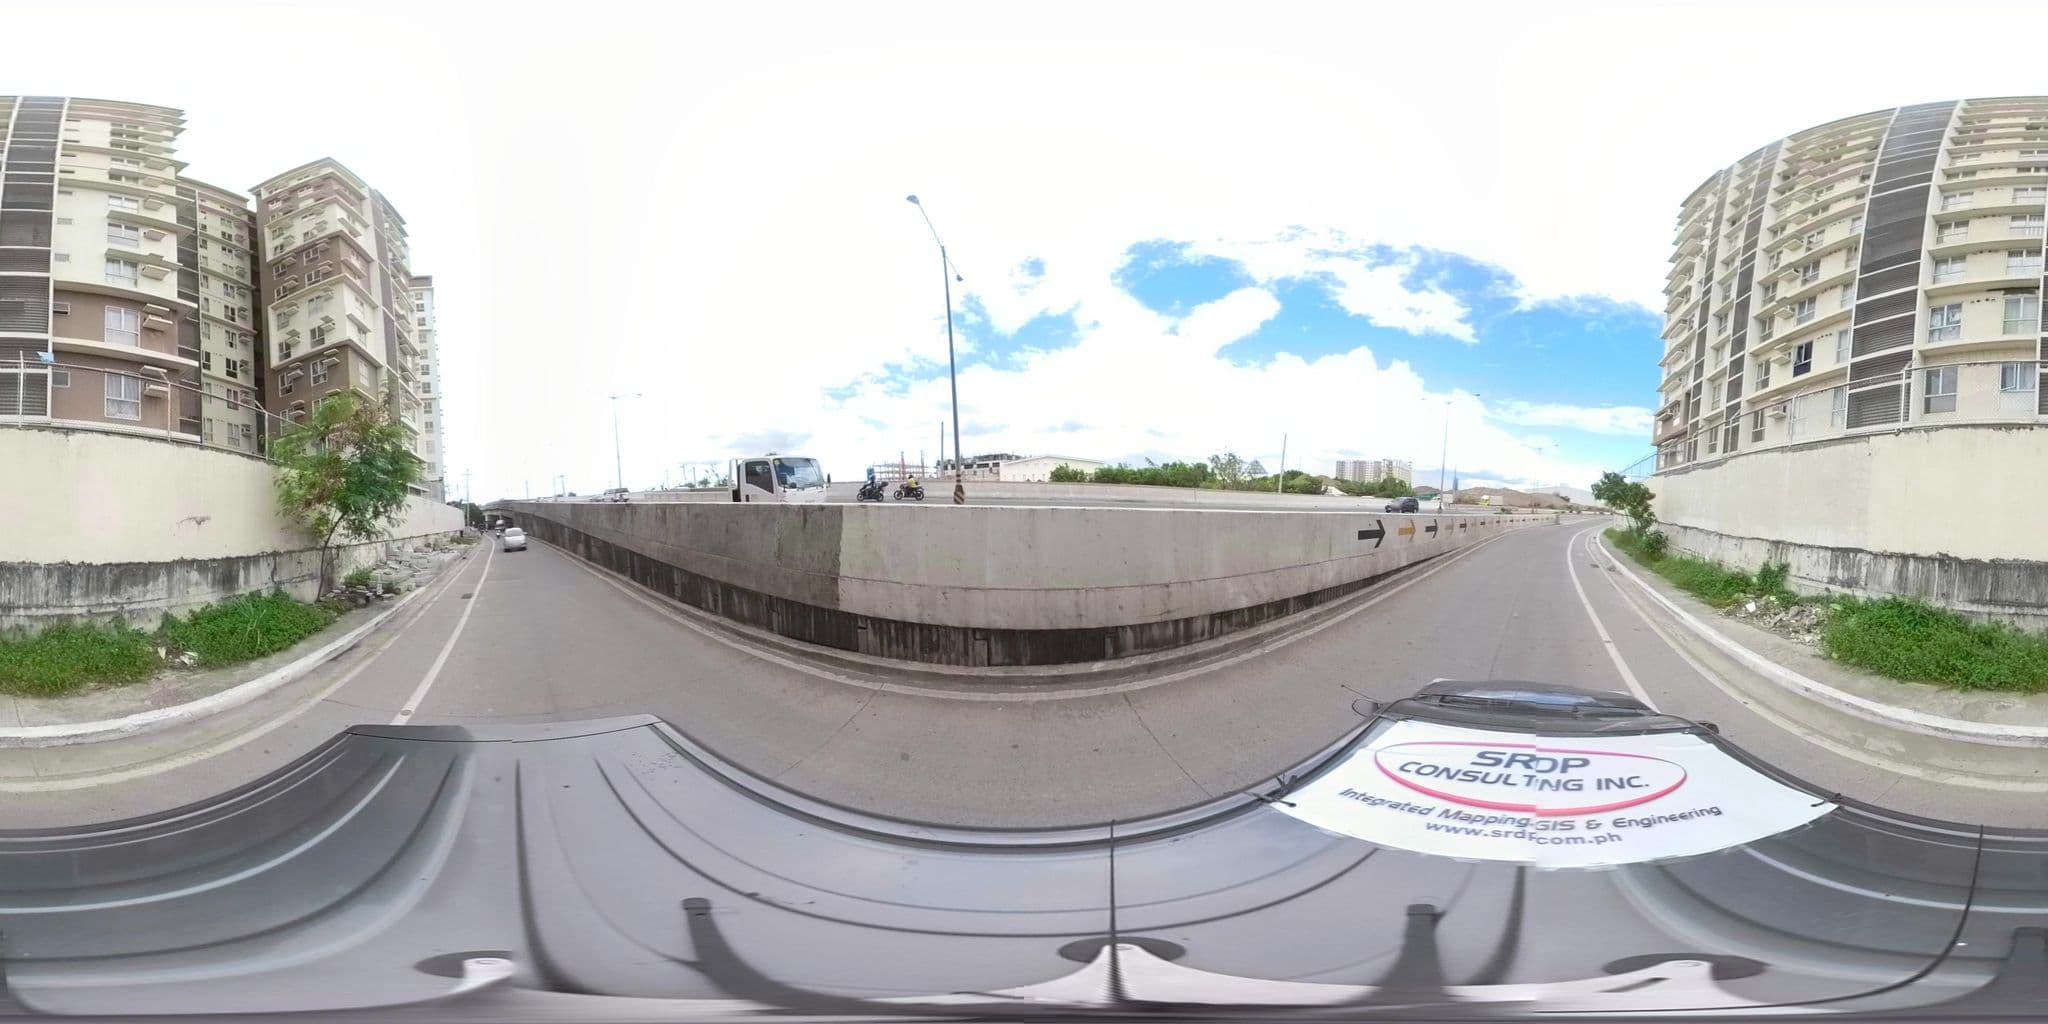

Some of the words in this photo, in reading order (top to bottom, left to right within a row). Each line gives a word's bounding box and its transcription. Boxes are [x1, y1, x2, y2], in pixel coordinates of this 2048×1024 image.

[1470, 750, 1591, 774] SRDP
[1398, 761, 1584, 791] CONSULTNG
[1596, 775, 1650, 791] INC.
[1338, 788, 1435, 816] Integrated
[1585, 819, 1603, 830] &
[1612, 805, 1723, 828] Engineering
[1425, 822, 1623, 845] www.srdpcom.ph
